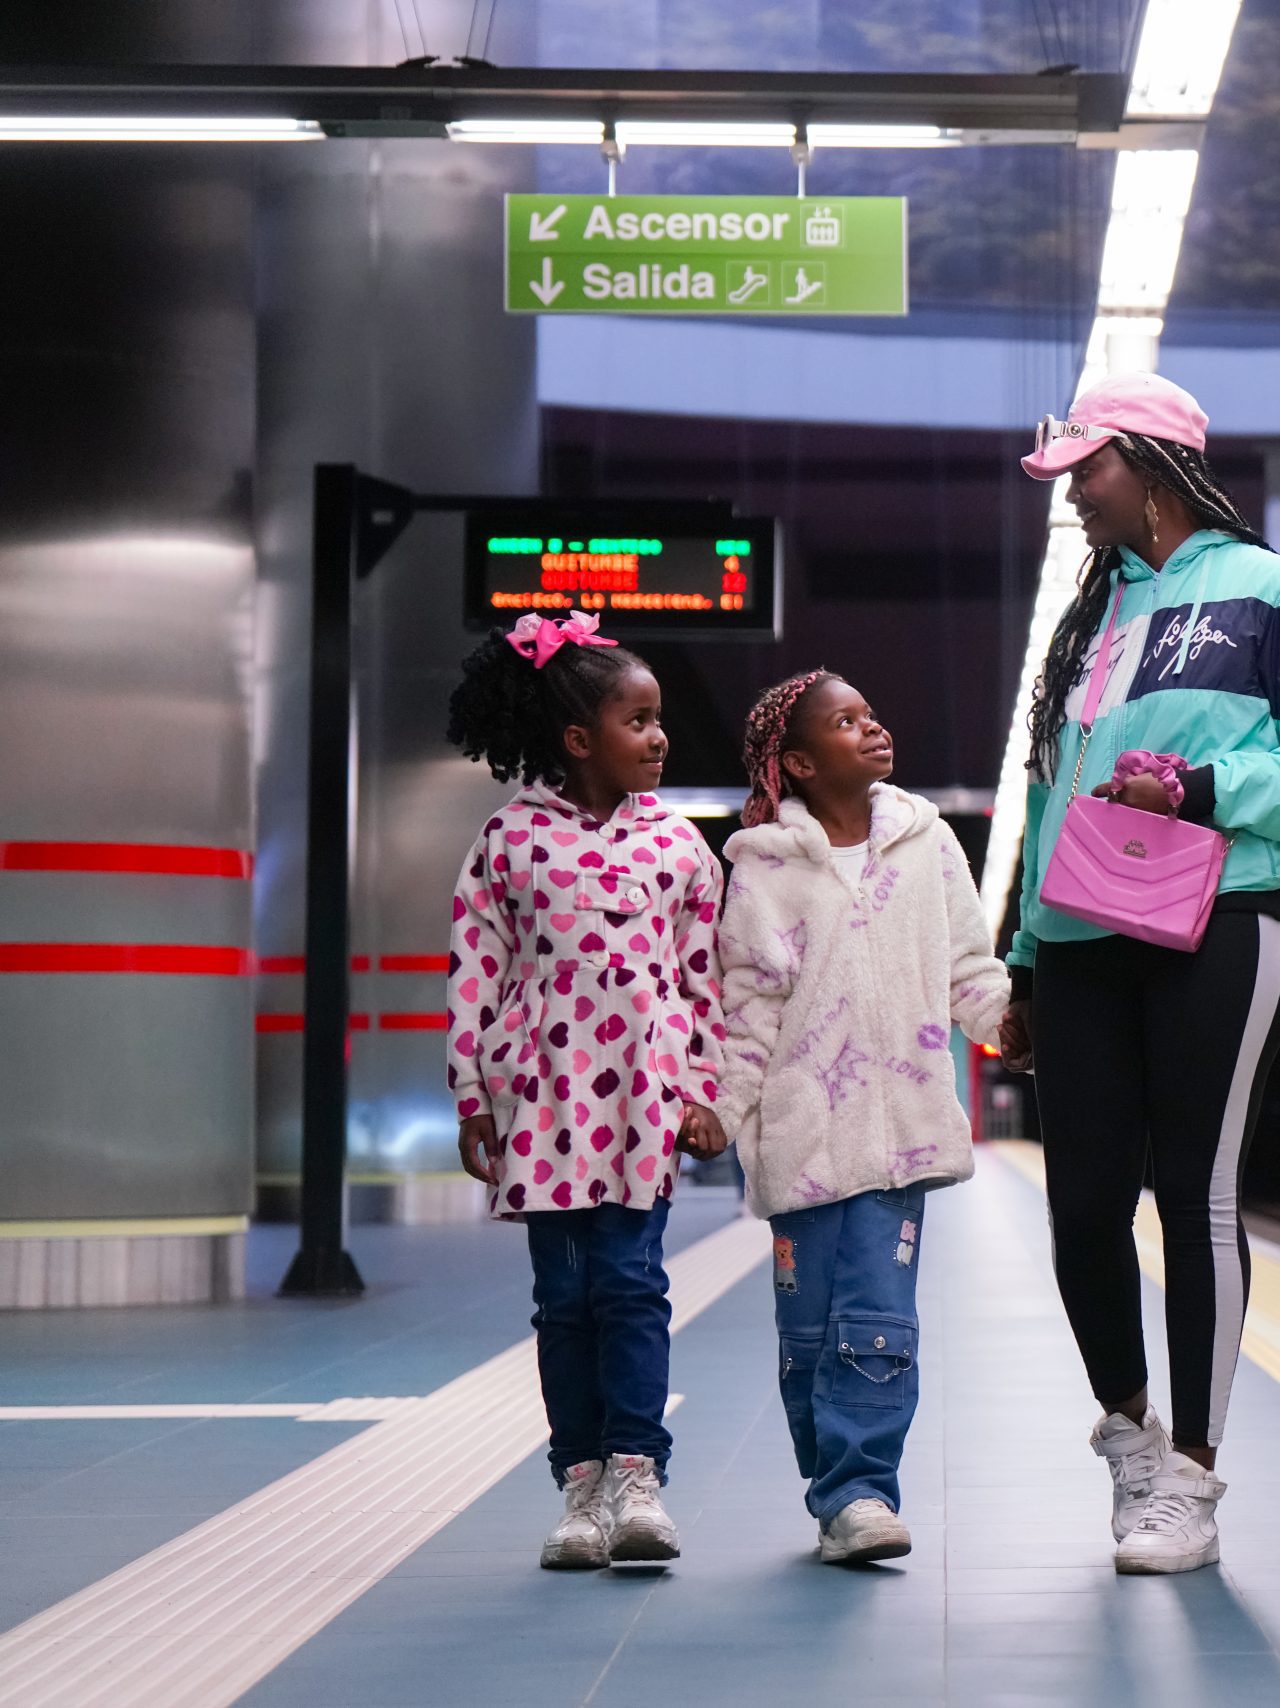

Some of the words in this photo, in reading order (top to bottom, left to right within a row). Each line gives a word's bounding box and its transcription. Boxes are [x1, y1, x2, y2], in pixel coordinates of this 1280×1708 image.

[583, 205, 790, 240] Ascensor
[583, 263, 715, 300] Salida
[871, 866, 900, 912] LOVE
[885, 1056, 933, 1084] LOVE
